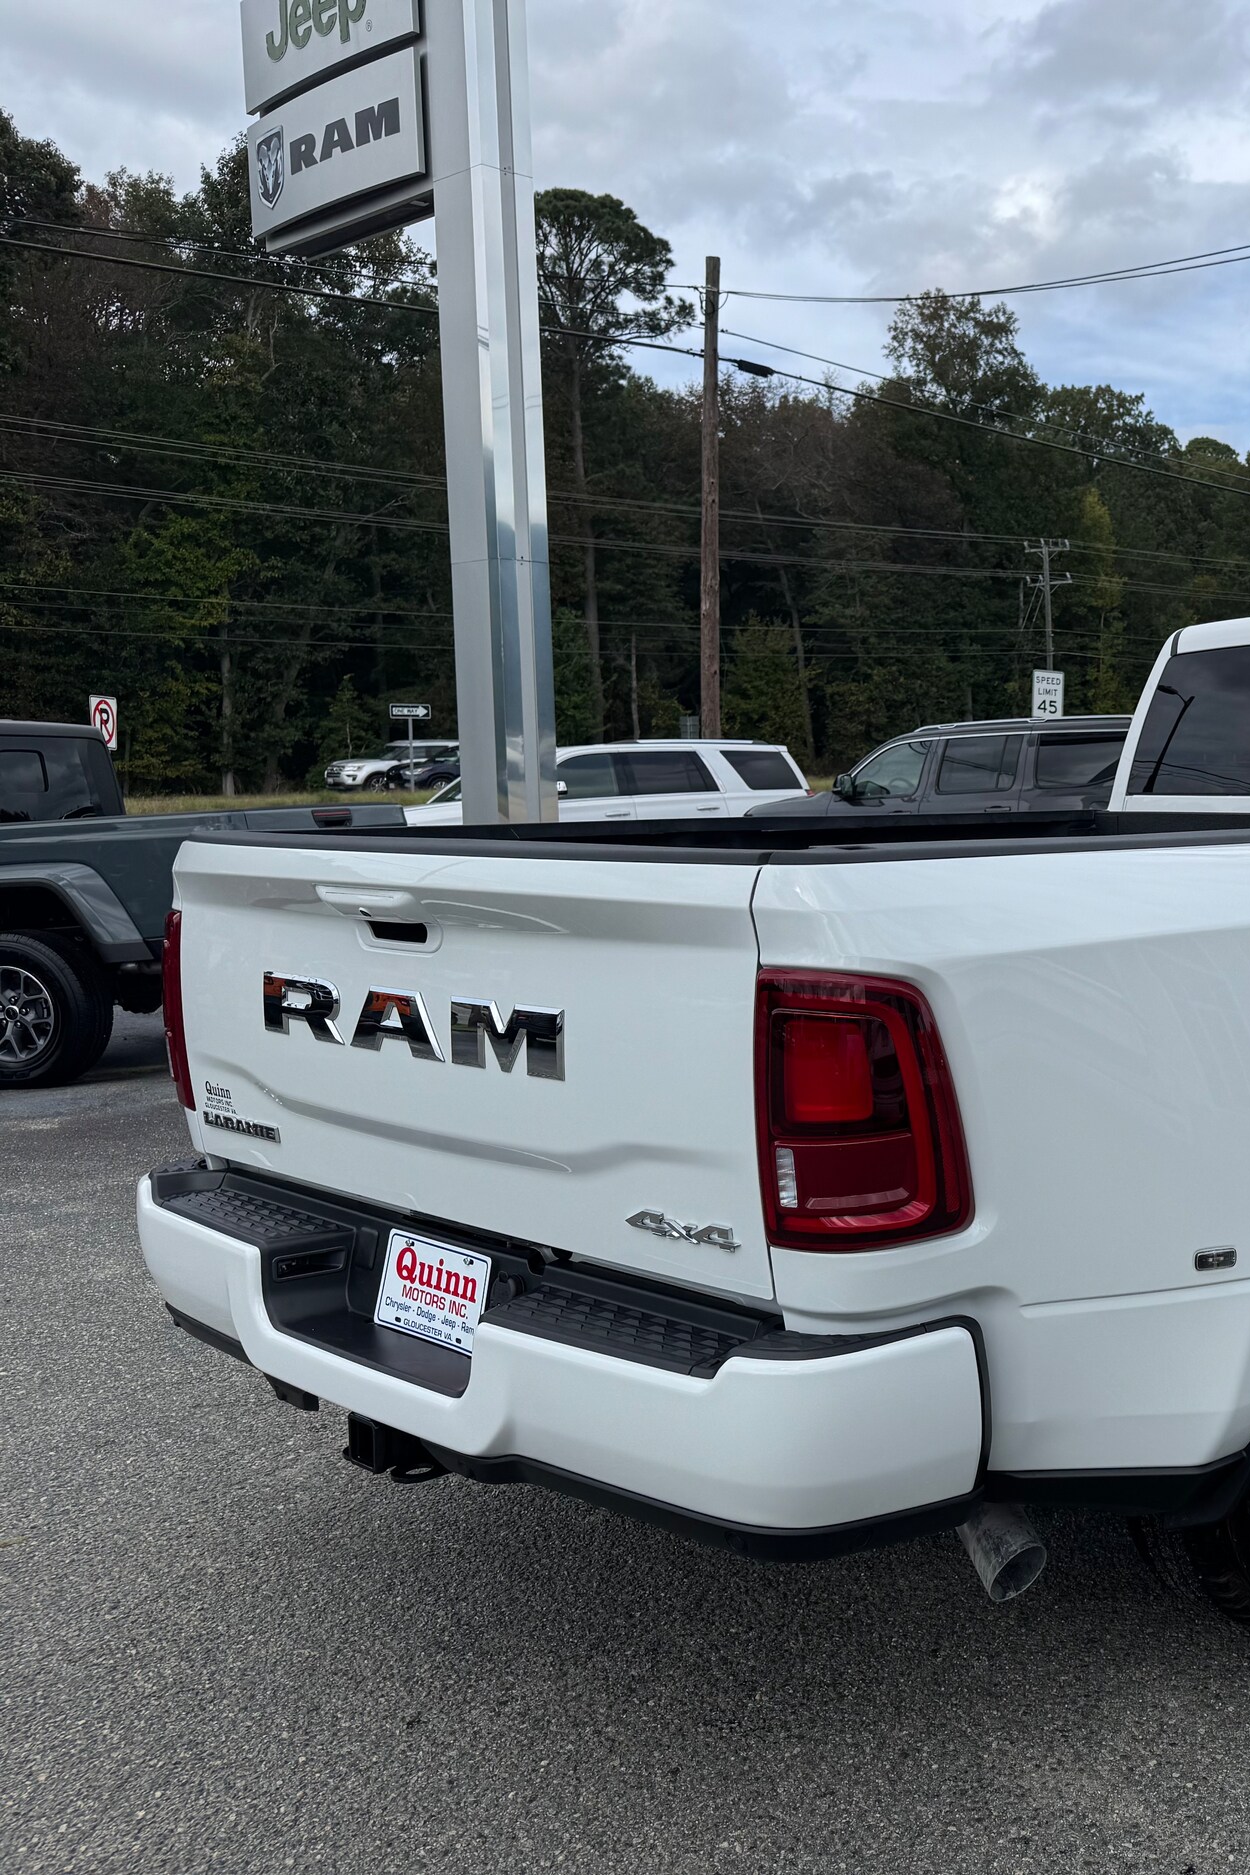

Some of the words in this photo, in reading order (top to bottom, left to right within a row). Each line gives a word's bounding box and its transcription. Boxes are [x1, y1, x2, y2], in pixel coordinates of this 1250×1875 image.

[265, 0, 367, 63] Jeep
[289, 97, 401, 175] RAM
[1035, 675, 1061, 686] SPEED
[1037, 687, 1058, 697] LIMIT
[1037, 699, 1058, 714] 45
[263, 971, 566, 1082] RAM
[204, 1080, 232, 1100] Quinn
[203, 1110, 281, 1144] LARAMIE
[396, 1246, 477, 1304] Quinn
[384, 1296, 412, 1313] Chrysler
[416, 1306, 437, 1323] Dodge
[440, 1315, 457, 1331] Jeep
[460, 1322, 475, 1336] Ram
[401, 1284, 447, 1311] MOTORS
[448, 1299, 469, 1320] INC.
[403, 1318, 443, 1338] GLOUCESTER
